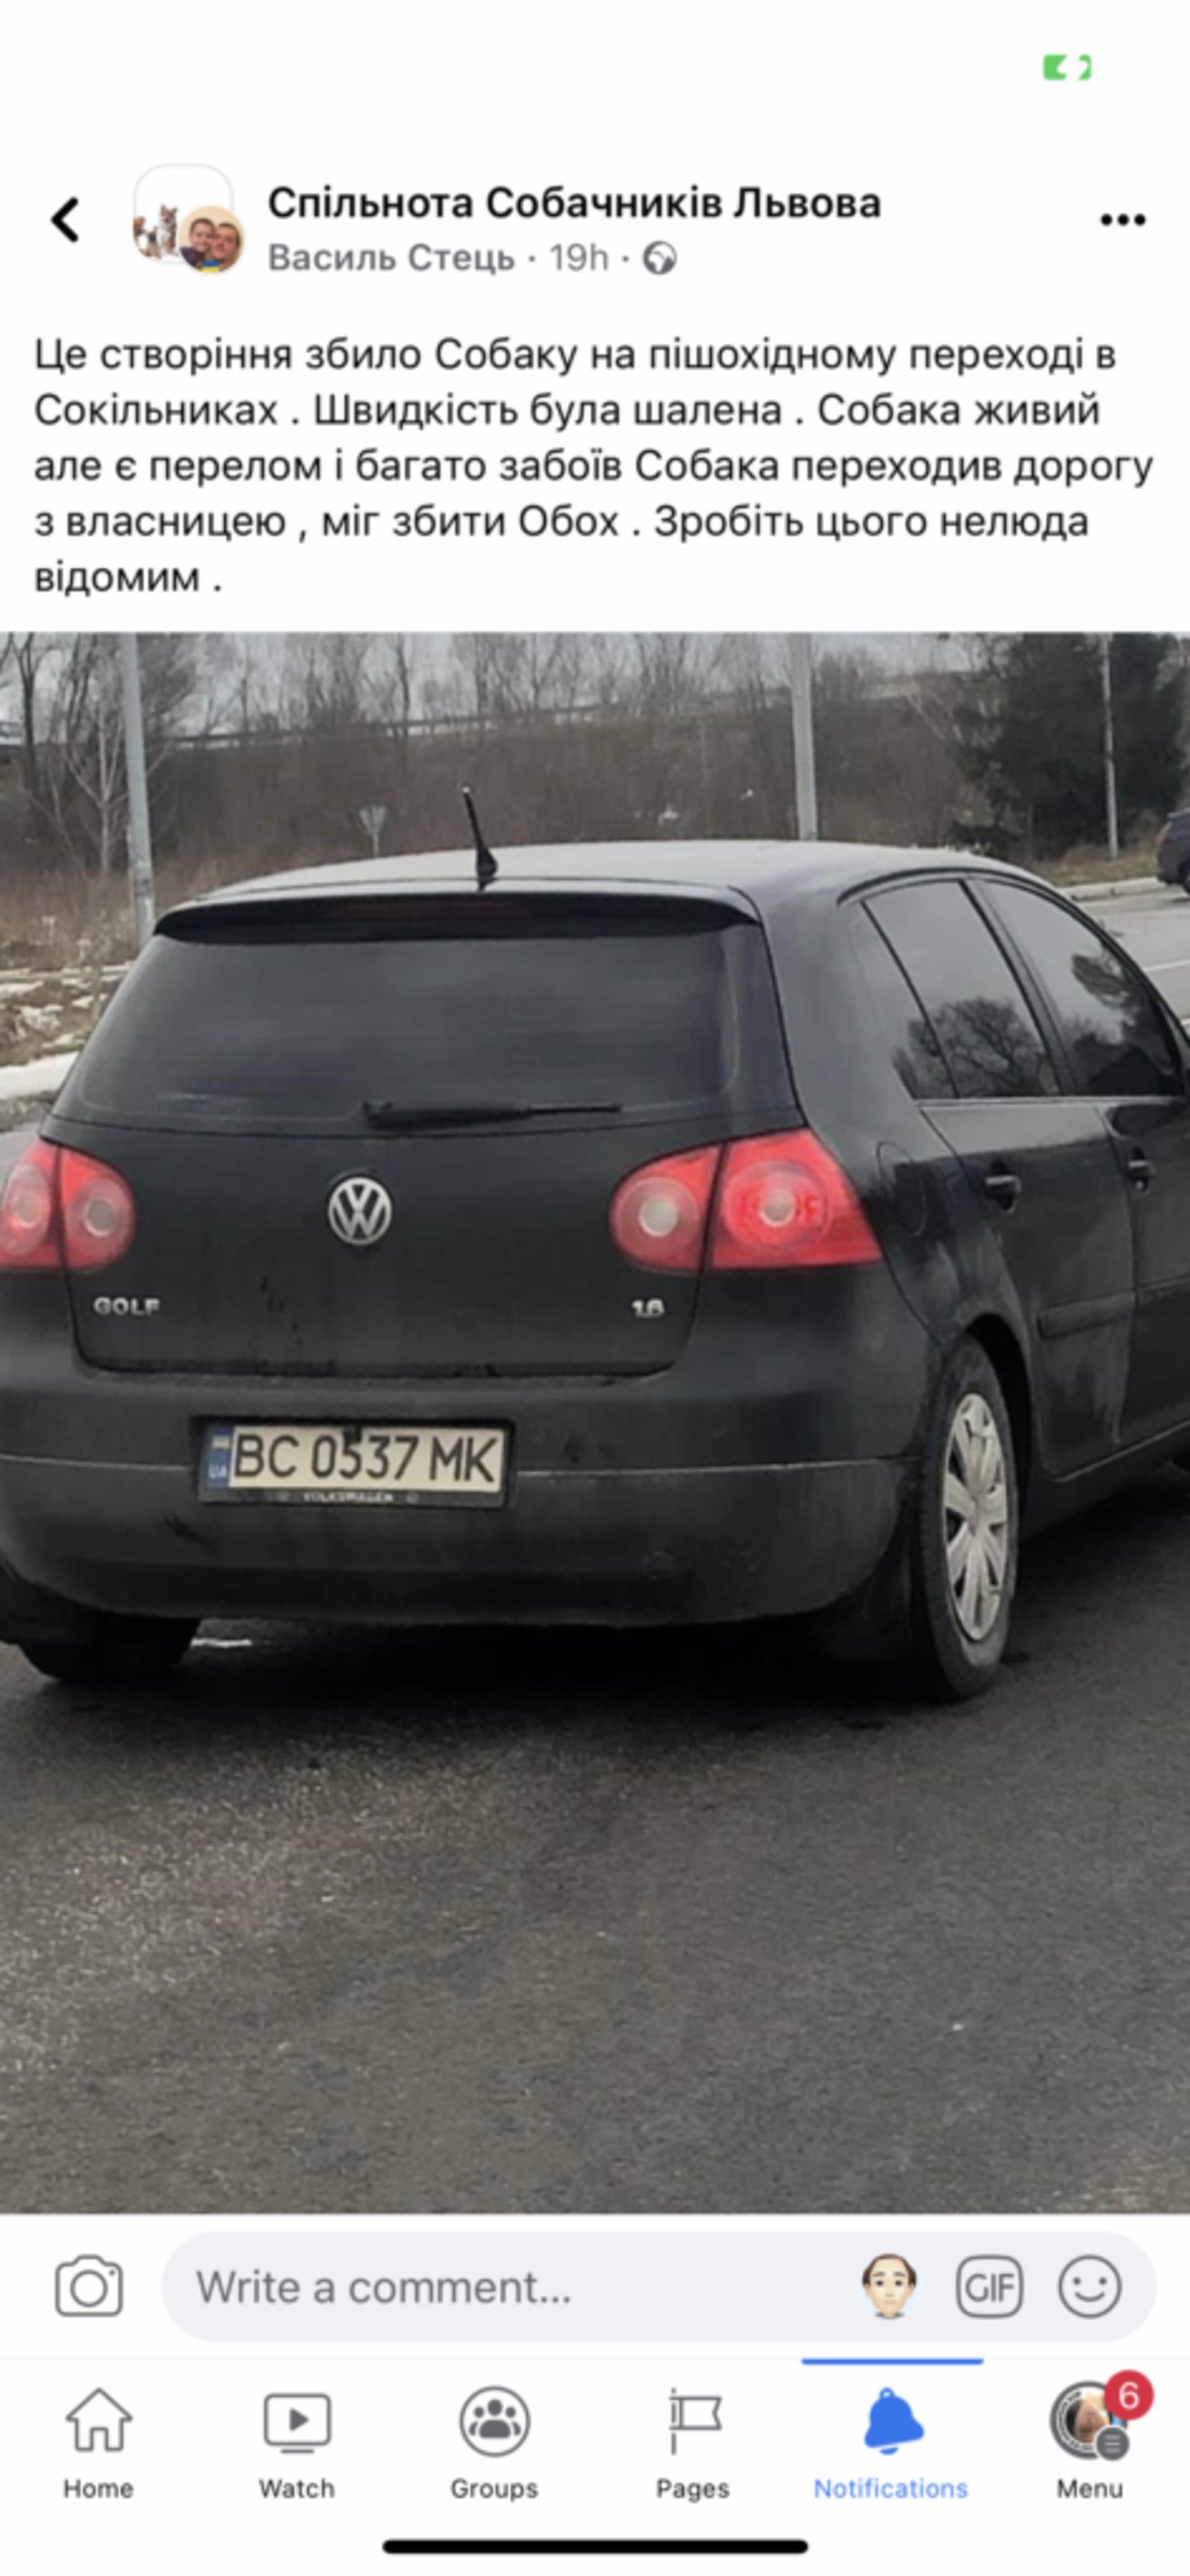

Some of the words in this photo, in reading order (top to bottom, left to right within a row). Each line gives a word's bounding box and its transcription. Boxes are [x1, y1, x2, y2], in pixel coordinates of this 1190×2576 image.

[328, 1177, 392, 1246] VW
[93, 1296, 161, 1316] GOLF
[234, 1433, 300, 1479] BC
[311, 1434, 420, 1480] 0537
[430, 1436, 498, 1484] MK
